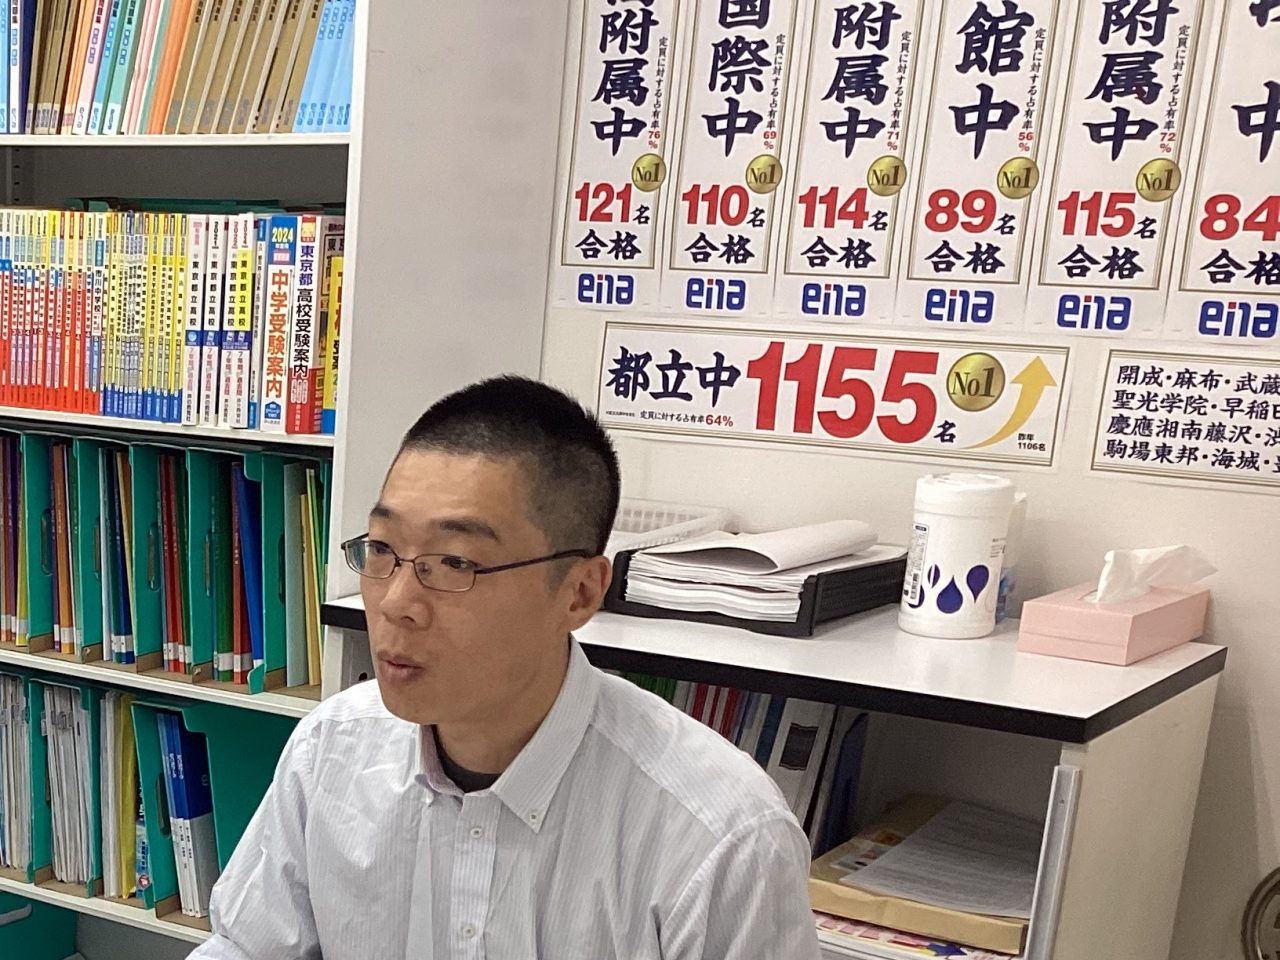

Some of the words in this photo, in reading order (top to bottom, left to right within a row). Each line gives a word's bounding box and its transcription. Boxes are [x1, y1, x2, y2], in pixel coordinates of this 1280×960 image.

[590, 0, 659, 157] 附属中
[820, 1, 902, 158] 附属中
[949, 0, 1034, 160] 館中
[1082, 0, 1180, 162] 附属中
[272, 228, 293, 242] 2024
[575, 229, 642, 260] 合格
[684, 233, 755, 264] 合格
[800, 236, 876, 269] 合格
[924, 240, 1006, 274] 合格
[1057, 244, 1144, 280] 合格
[1200, 249, 1280, 285] 合格
[265, 270, 289, 398] 中学受験案内
